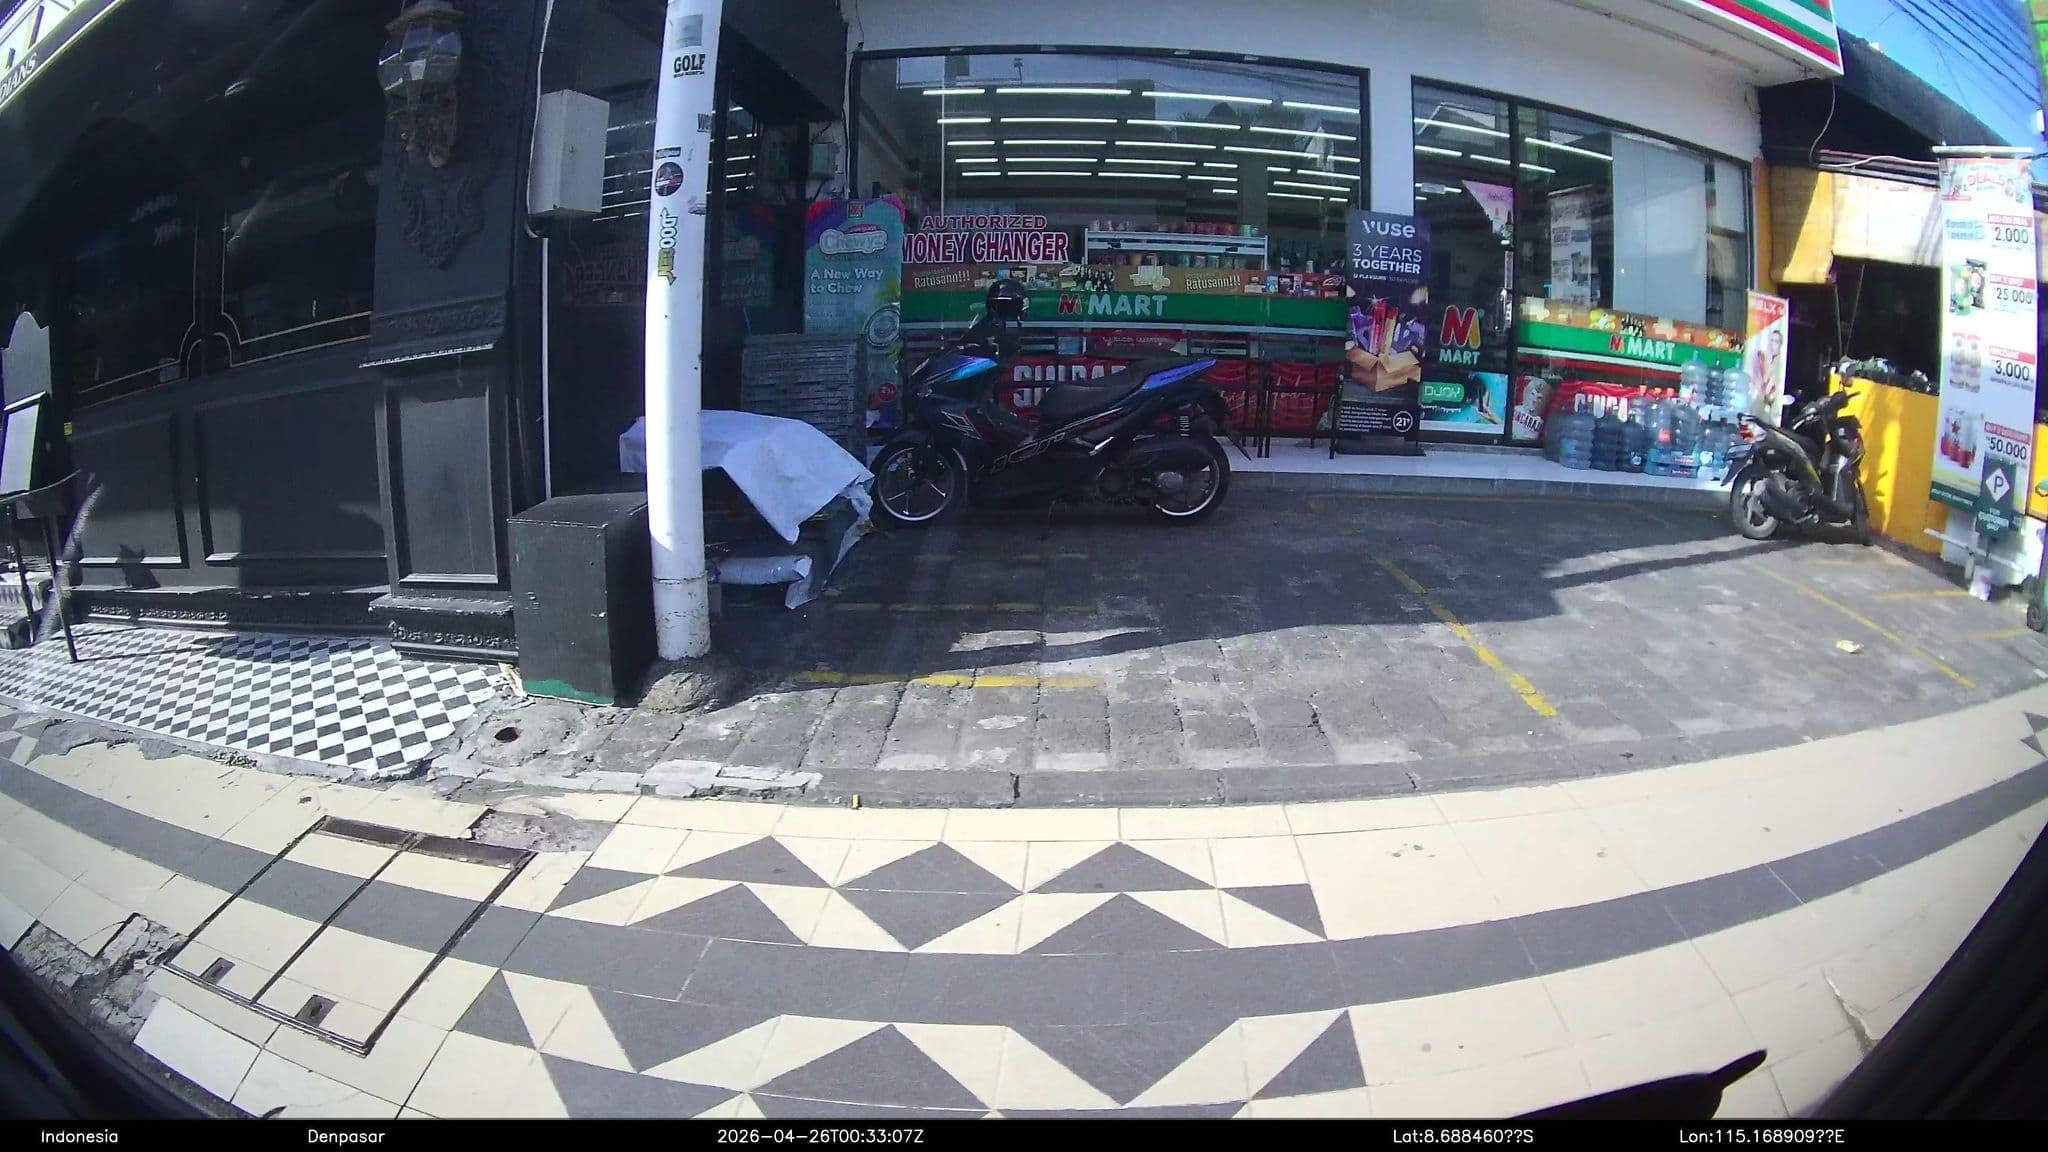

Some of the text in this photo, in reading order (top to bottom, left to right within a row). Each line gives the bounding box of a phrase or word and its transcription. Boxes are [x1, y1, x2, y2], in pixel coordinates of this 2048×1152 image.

[674, 54, 706, 73] GOLF
[921, 215, 1048, 231] AUTHORIZED
[1995, 226, 2028, 244] 2.000
[971, 231, 1069, 264] CHANGER
[1353, 243, 1422, 263] 3 YEARS
[811, 268, 883, 280] A New Way
[1352, 258, 1421, 274] TOGETHER
[810, 284, 825, 293] to
[1088, 294, 1168, 316] MART
[1439, 348, 1480, 365] MART
[1627, 338, 1676, 361] MART
[1995, 360, 2030, 381] 3.000
[1993, 475, 2004, 493] P
